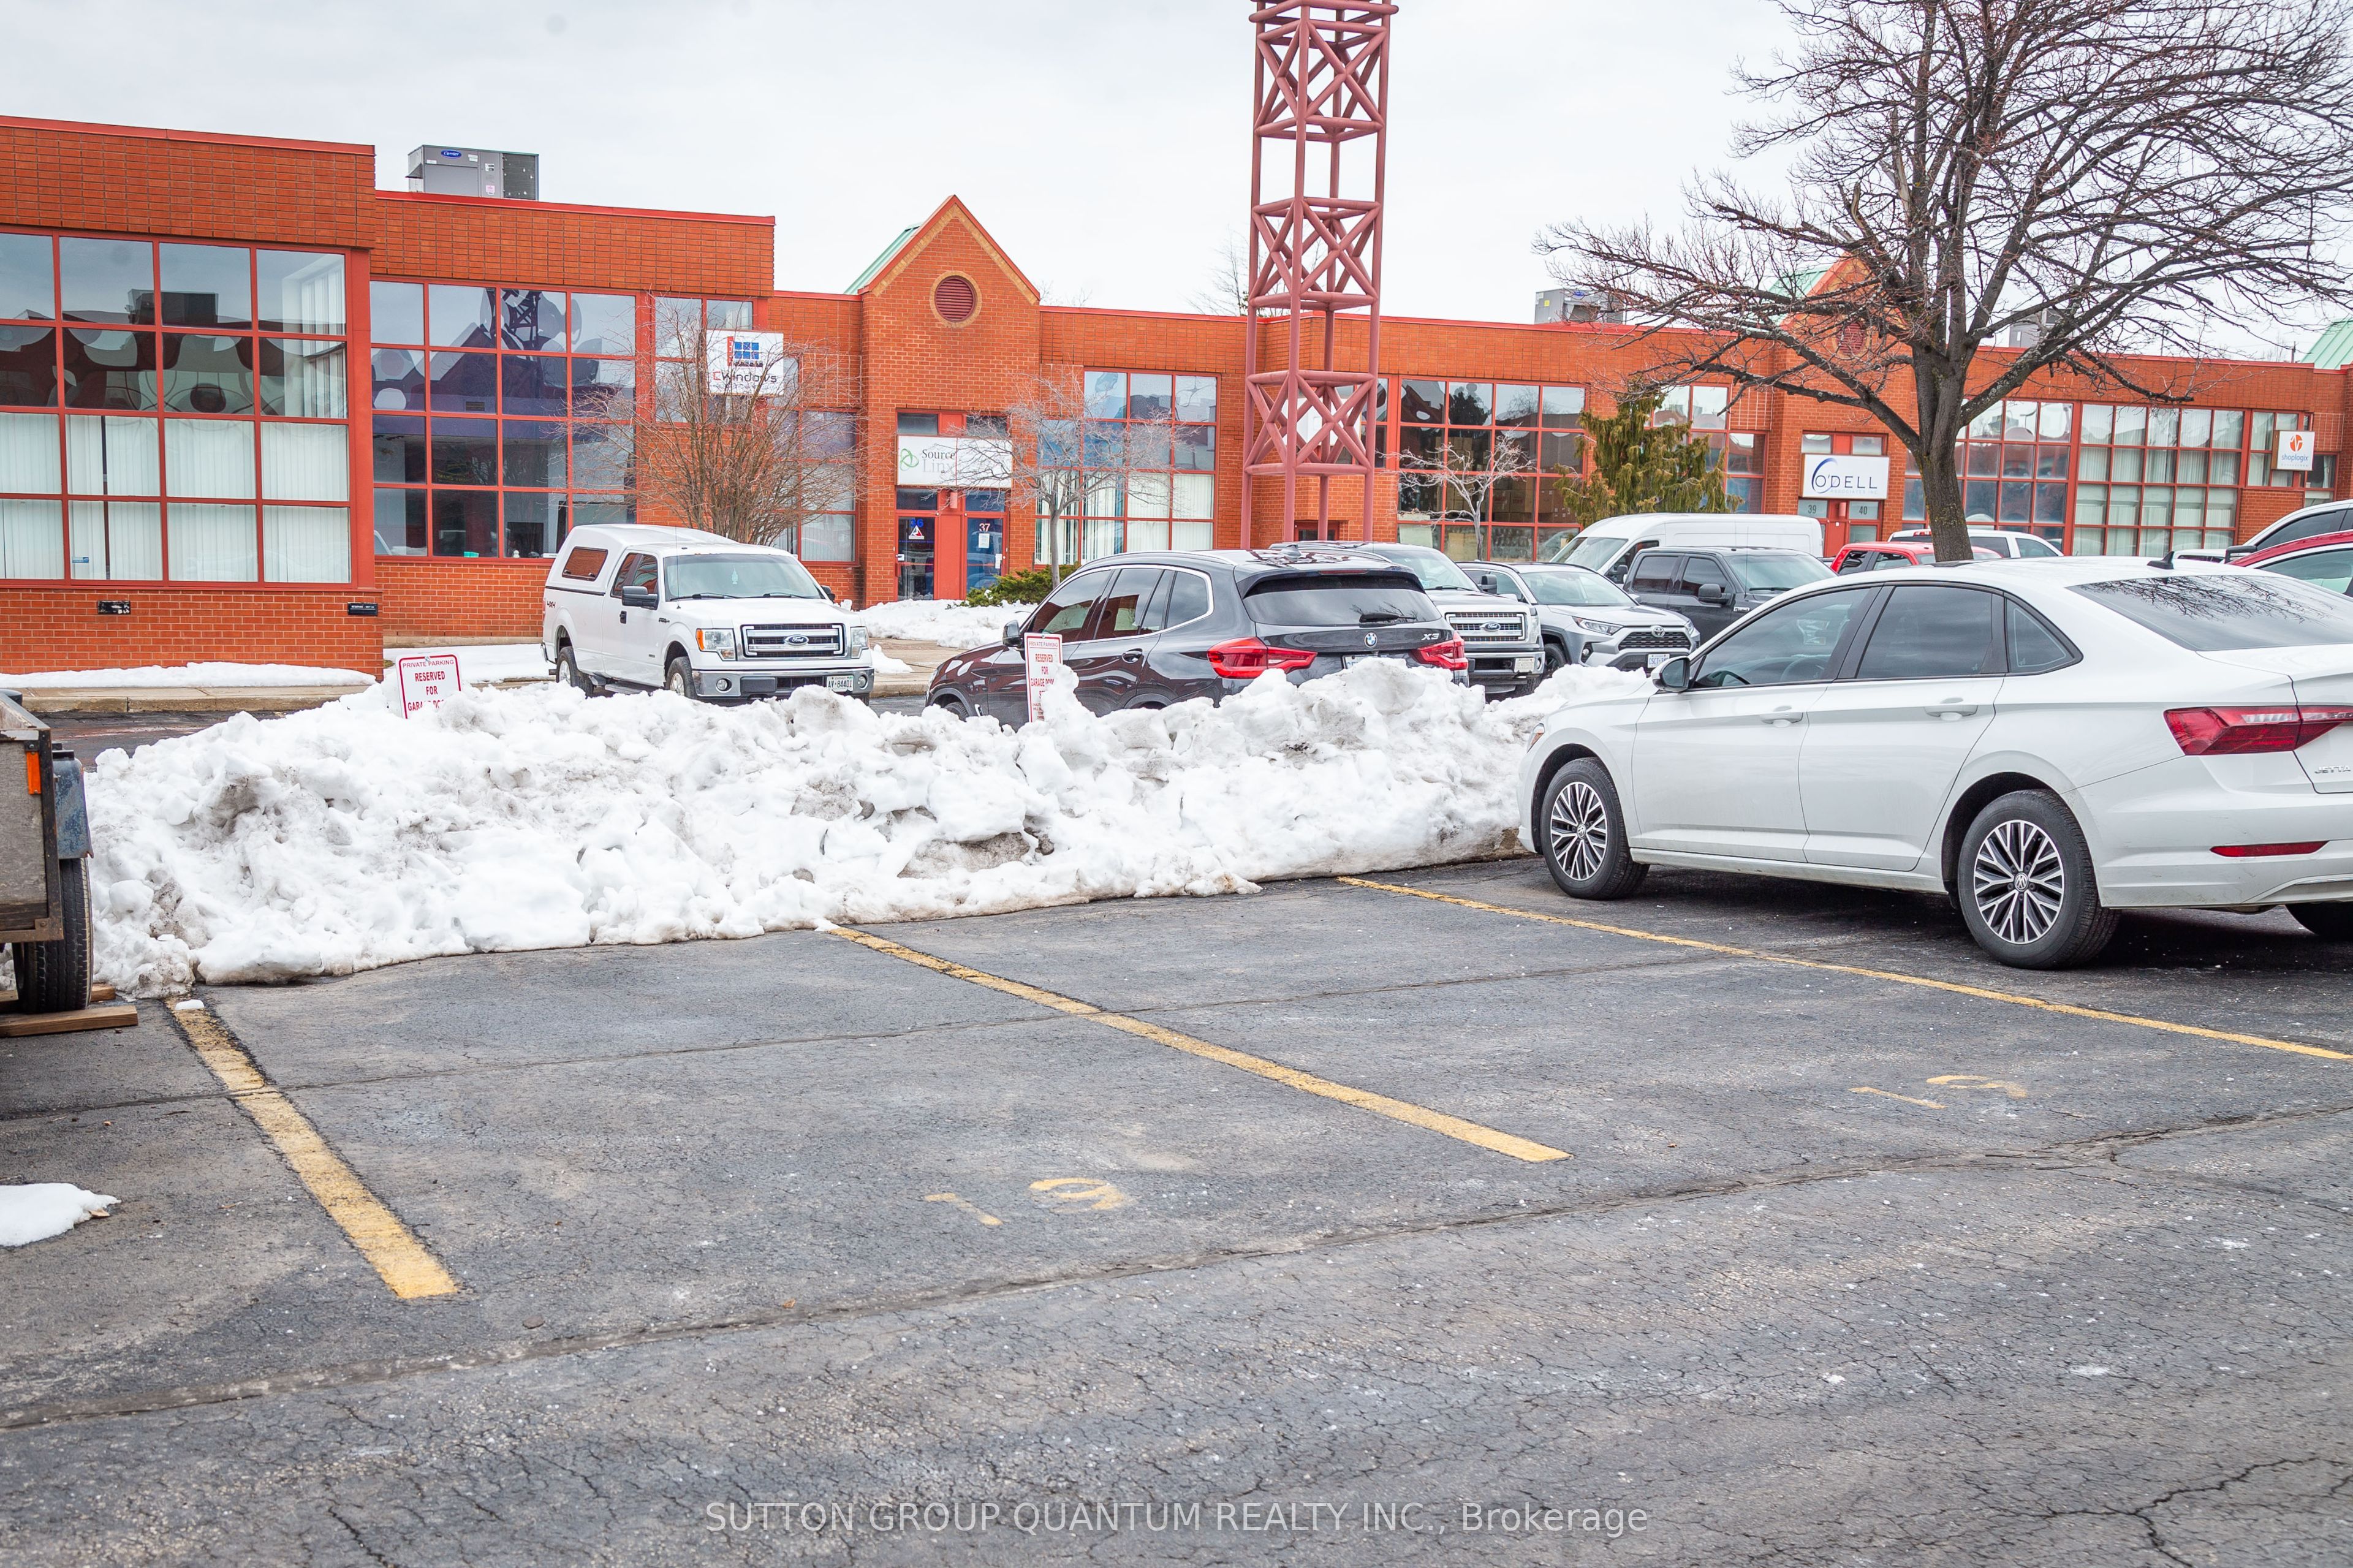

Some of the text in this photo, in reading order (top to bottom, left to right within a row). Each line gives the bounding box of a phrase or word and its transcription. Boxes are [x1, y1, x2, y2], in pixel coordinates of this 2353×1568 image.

[922, 449, 955, 460] Source
[1815, 475, 1877, 489] O'DELL
[1808, 504, 1817, 514] 39
[1859, 506, 1868, 515] 40
[909, 518, 924, 529] 36
[979, 523, 990, 532] 37
[1036, 654, 1053, 662] RESERVED
[415, 671, 445, 682] RESERVED
[1031, 678, 1045, 686] GARAGE
[426, 686, 438, 695] FOR
